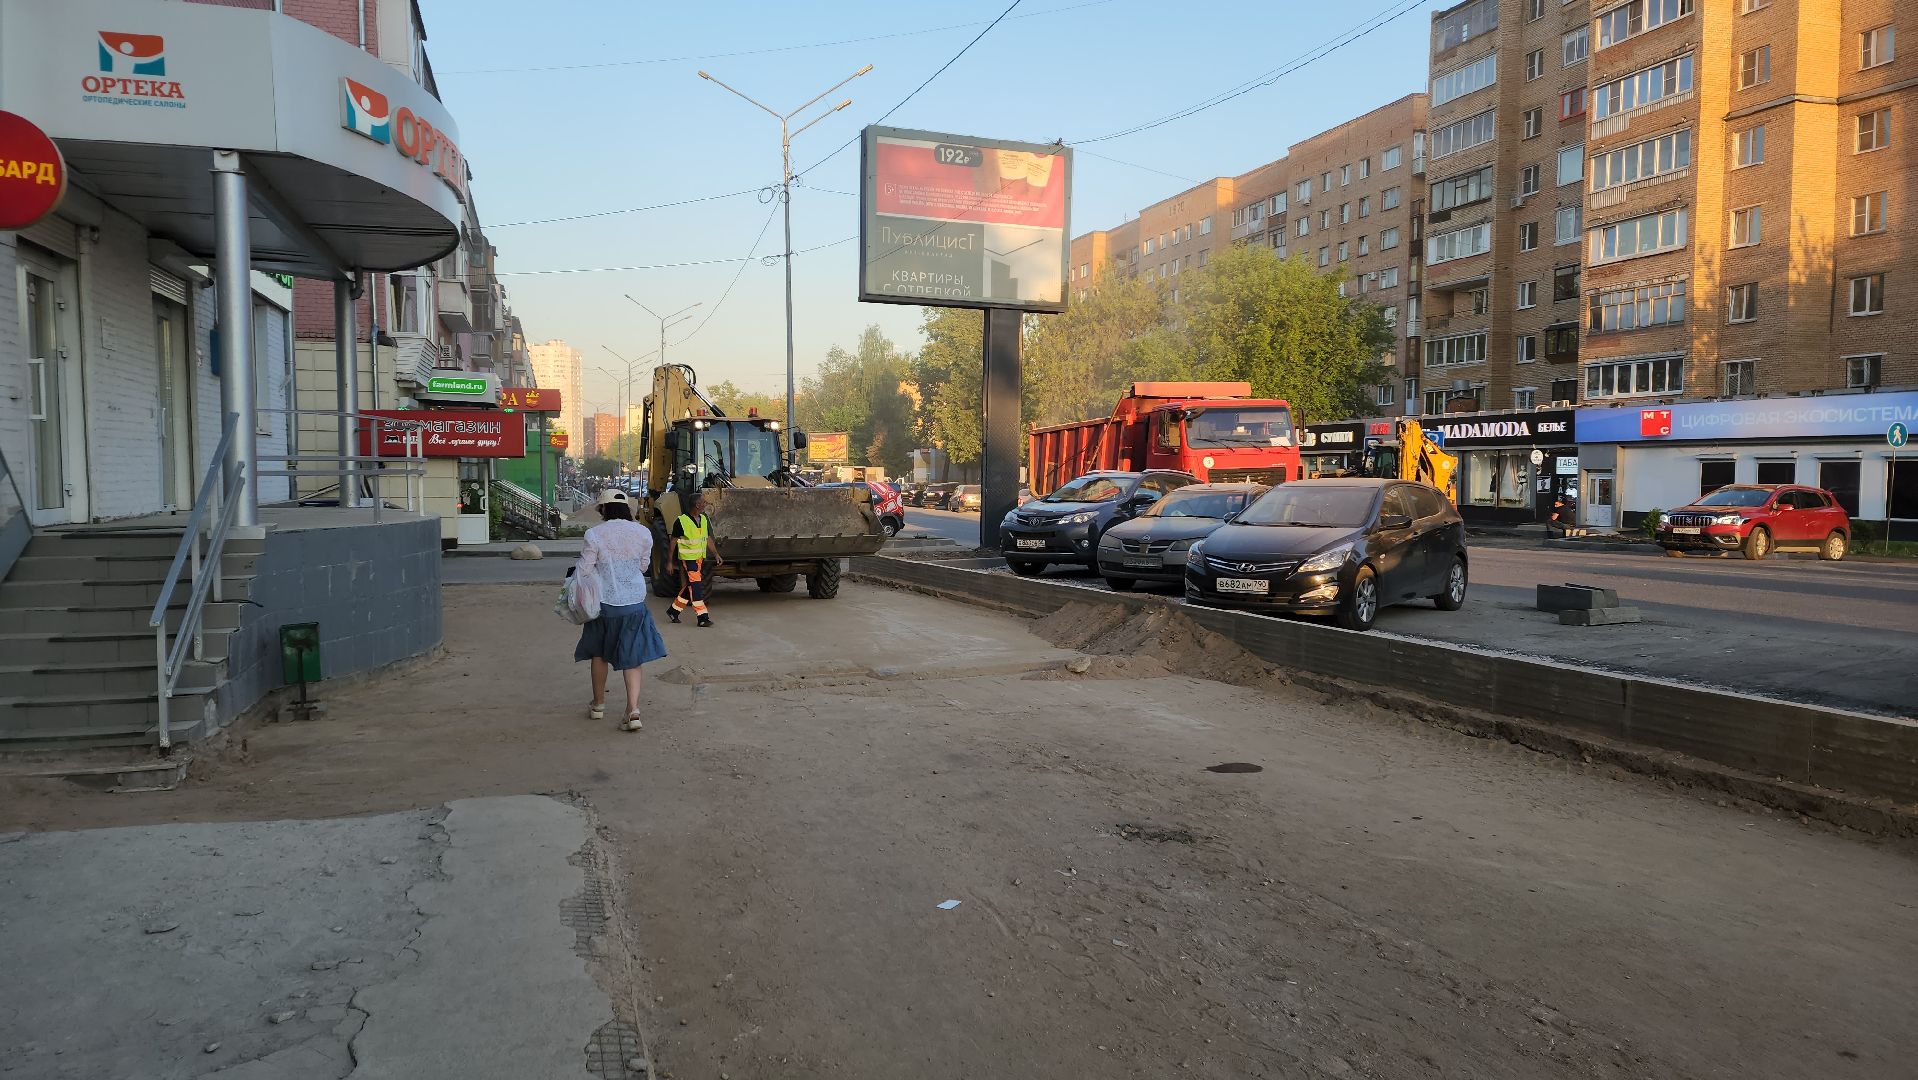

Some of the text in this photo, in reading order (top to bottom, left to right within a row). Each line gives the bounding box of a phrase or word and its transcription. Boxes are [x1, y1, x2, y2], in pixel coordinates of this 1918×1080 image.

[82, 76, 185, 99] ОРТЕКА
[82, 95, 186, 109] ОРТОПЕДИЧЕСКИЕ САЛОНЫ
[892, 269, 964, 286] КВАРТИРЫ
[432, 380, 483, 391] farmland.ru
[1681, 411, 1780, 428] ЦИФРОВАЯ
[1537, 422, 1567, 433] БЕЛЬЕ
